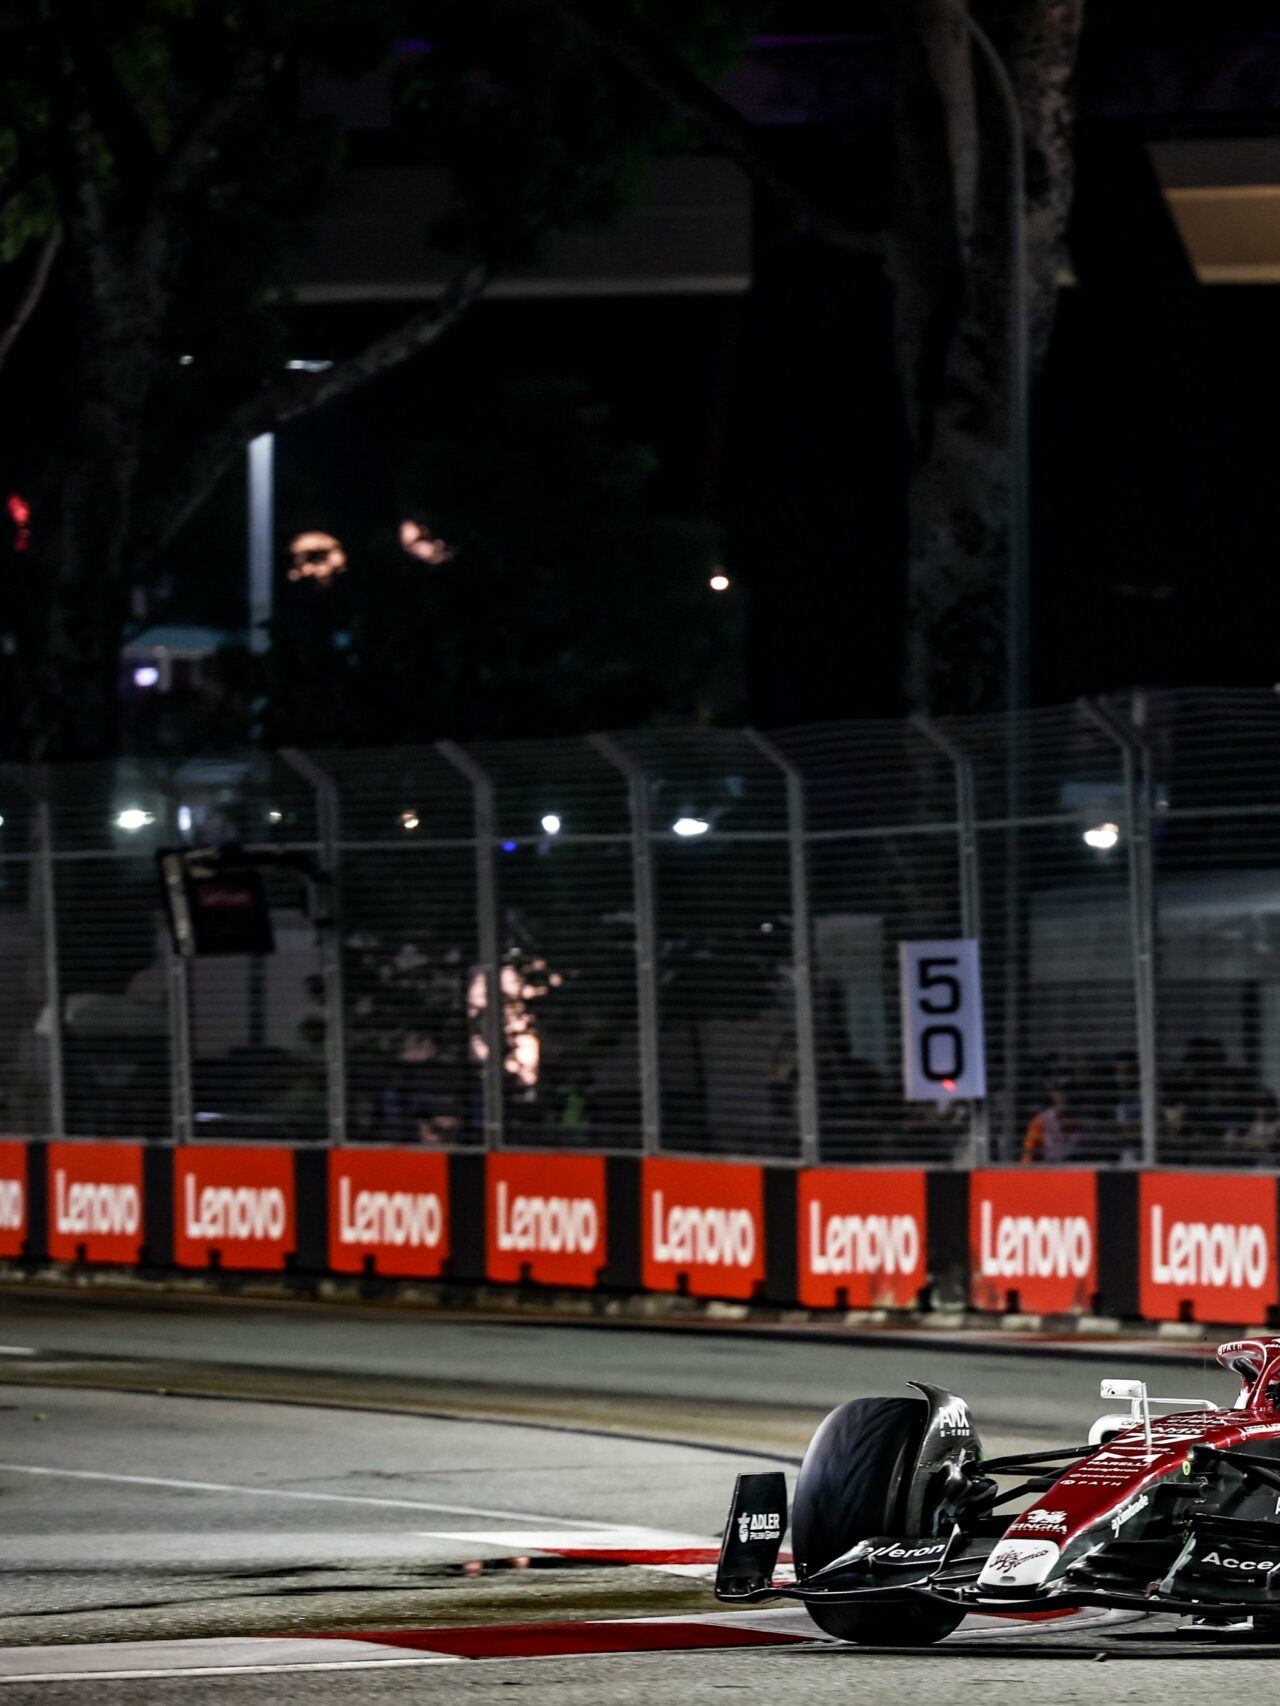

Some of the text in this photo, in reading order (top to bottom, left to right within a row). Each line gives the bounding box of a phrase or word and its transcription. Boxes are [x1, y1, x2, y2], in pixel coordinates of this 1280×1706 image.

[918, 957, 964, 1083] 50
[56, 1169, 140, 1235] Lenovo
[186, 1173, 286, 1240] Lenovo
[340, 1177, 442, 1248] Lenovo
[497, 1182, 598, 1254] Lenovo
[652, 1190, 756, 1268] Lenovo
[810, 1200, 919, 1275] Lenovo
[977, 1199, 1092, 1279] Lenovo
[1151, 1205, 1269, 1289] Lenovo
[750, 1513, 780, 1530] ADLER
